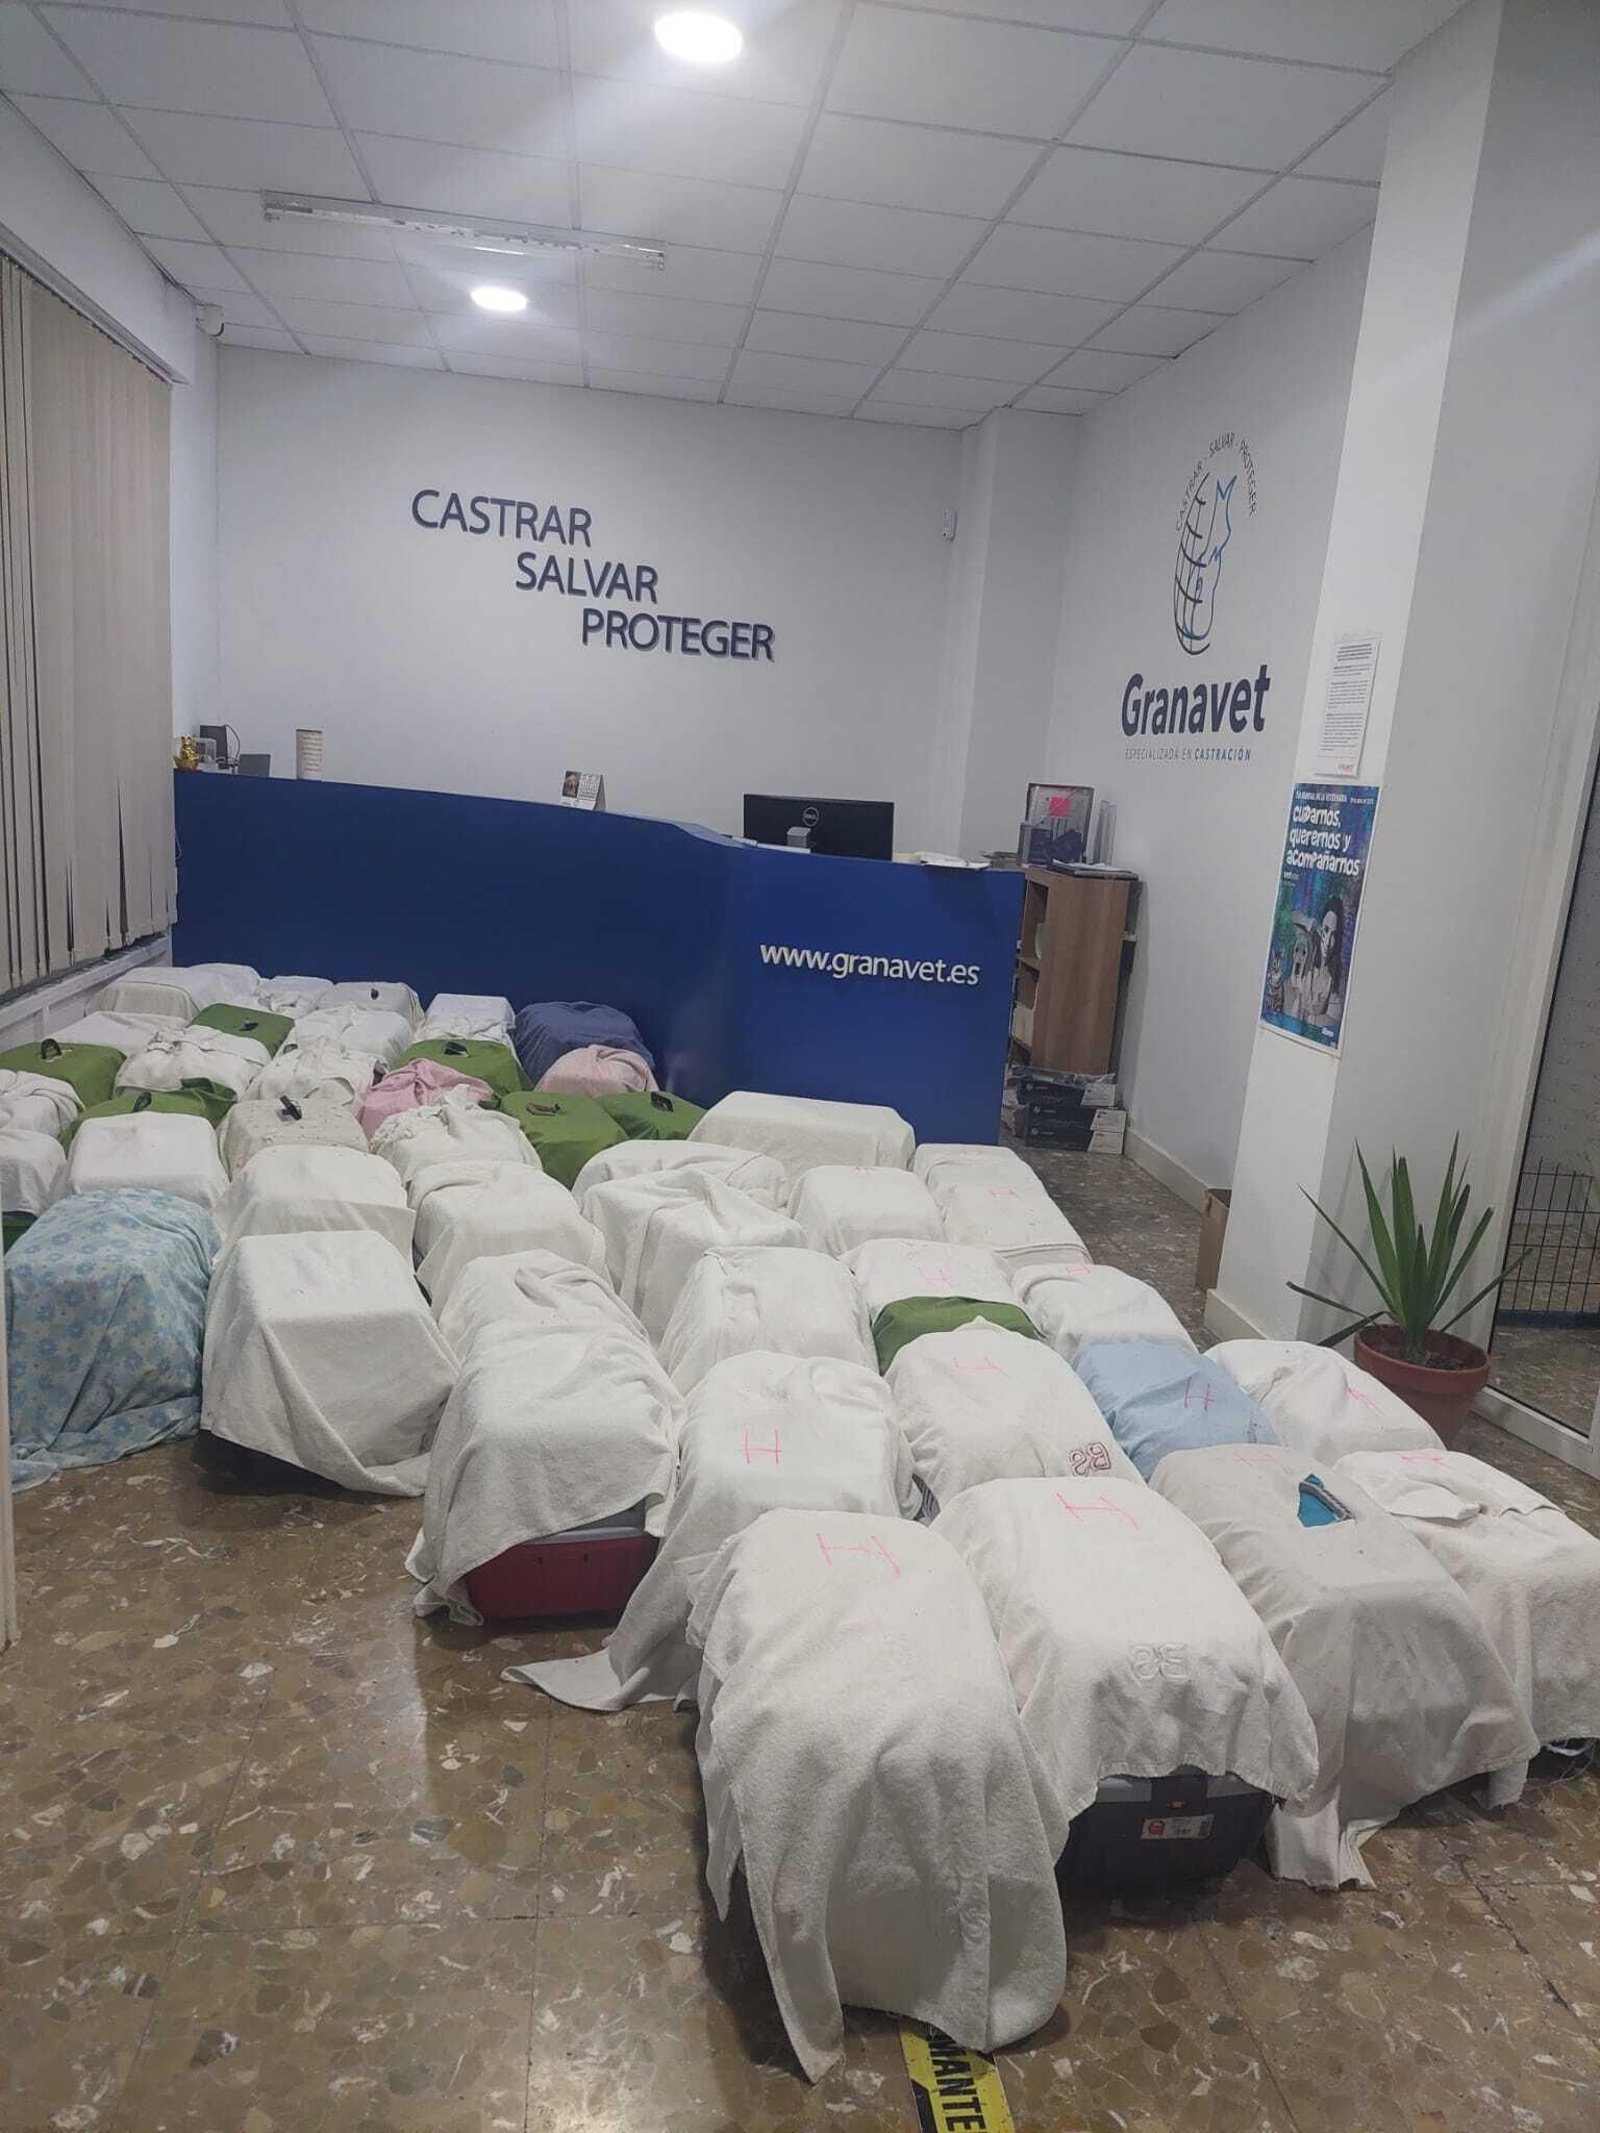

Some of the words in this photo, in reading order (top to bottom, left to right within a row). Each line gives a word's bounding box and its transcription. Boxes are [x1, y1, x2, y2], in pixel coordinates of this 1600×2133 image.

[411, 489, 593, 548] CASTRAR
[515, 552, 659, 604] SALVAR
[581, 608, 776, 662] PROTEGER
[1121, 664, 1271, 737] Granavet
[1125, 748, 1179, 761] ESPECIALIZADA
[1181, 748, 1193, 760] EN
[1194, 745, 1251, 761] CASTRACIÓN
[1342, 833, 1352, 853] y
[760, 943, 981, 986] www.granavet.es
[1184, 1376, 1215, 1412] H
[742, 1425, 782, 1465] H
[1056, 1492, 1140, 1531] H
[815, 1532, 901, 1580] H
